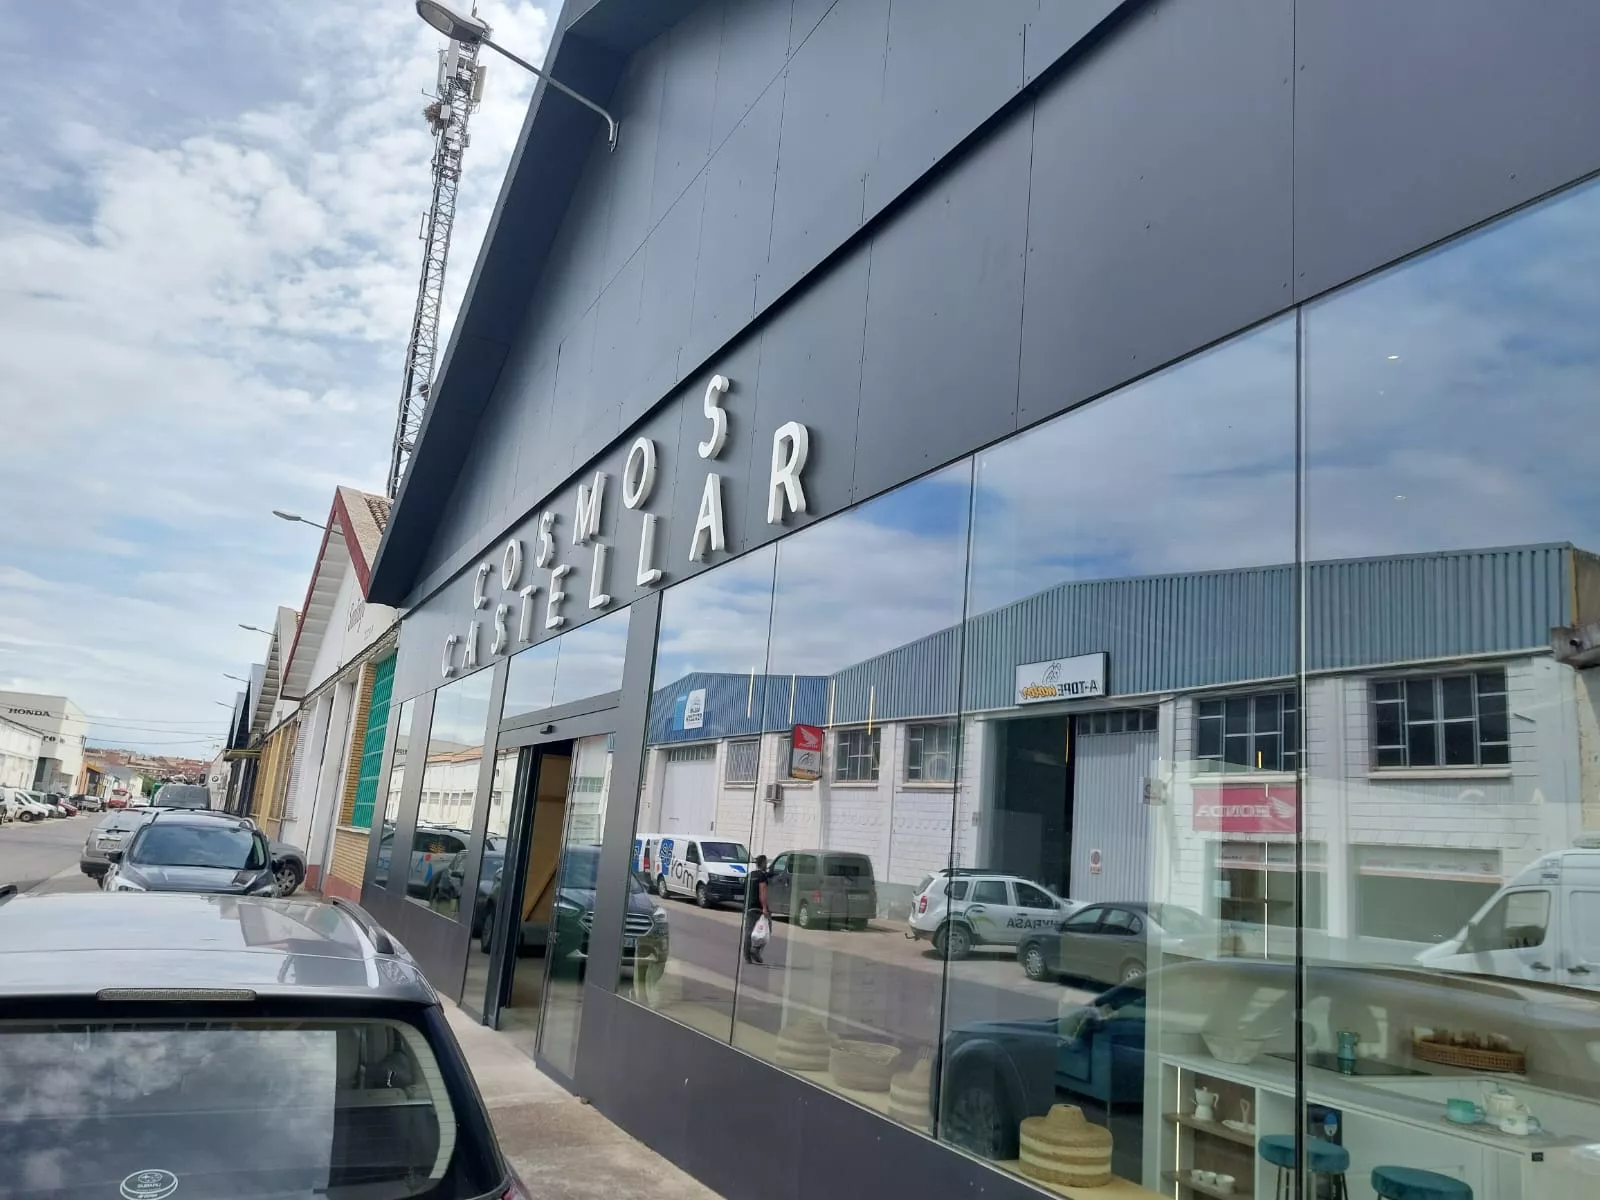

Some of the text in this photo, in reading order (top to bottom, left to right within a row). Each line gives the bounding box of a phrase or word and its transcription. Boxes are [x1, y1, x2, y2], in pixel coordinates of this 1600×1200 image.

[441, 421, 810, 679] CASTELLAR
[473, 374, 731, 611] COSMOS
[8, 707, 51, 717] HONDA
